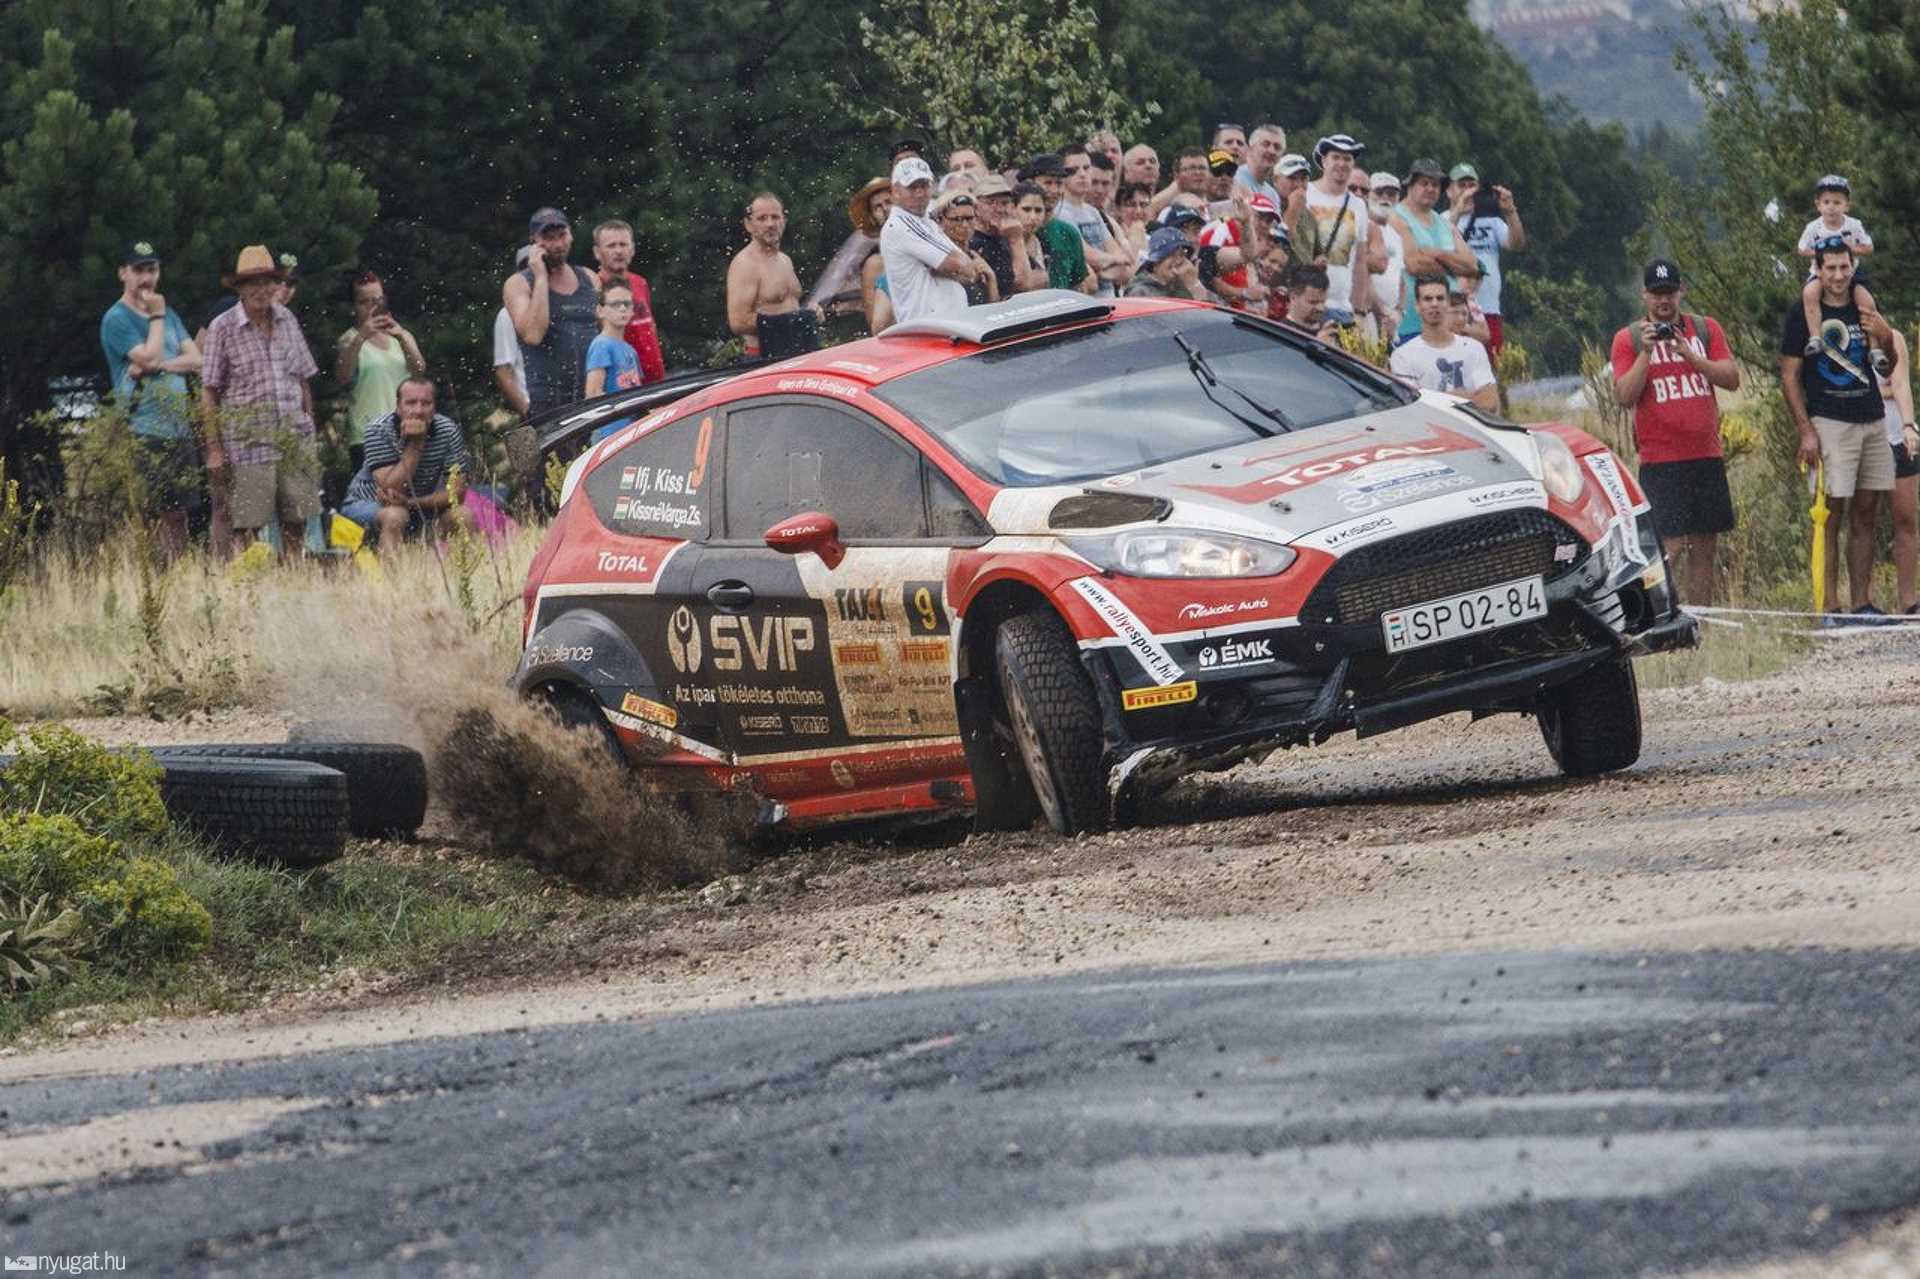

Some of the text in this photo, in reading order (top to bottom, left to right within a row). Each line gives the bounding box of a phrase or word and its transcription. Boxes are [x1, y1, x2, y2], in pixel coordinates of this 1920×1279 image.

[1262, 446, 1447, 486] TOTAL
[655, 467, 684, 495] Kiss
[780, 525, 817, 538] TOTAL
[598, 551, 649, 573] TOTAL
[914, 586, 937, 631] 9
[1238, 597, 1269, 612] Autó
[1079, 580, 1176, 680] www.rallyesport.hu
[1391, 631, 1406, 648] H
[710, 615, 815, 672] SVIP
[1220, 638, 1274, 663] ÉMK
[675, 683, 826, 707] Az ipar tökéletes otthona
